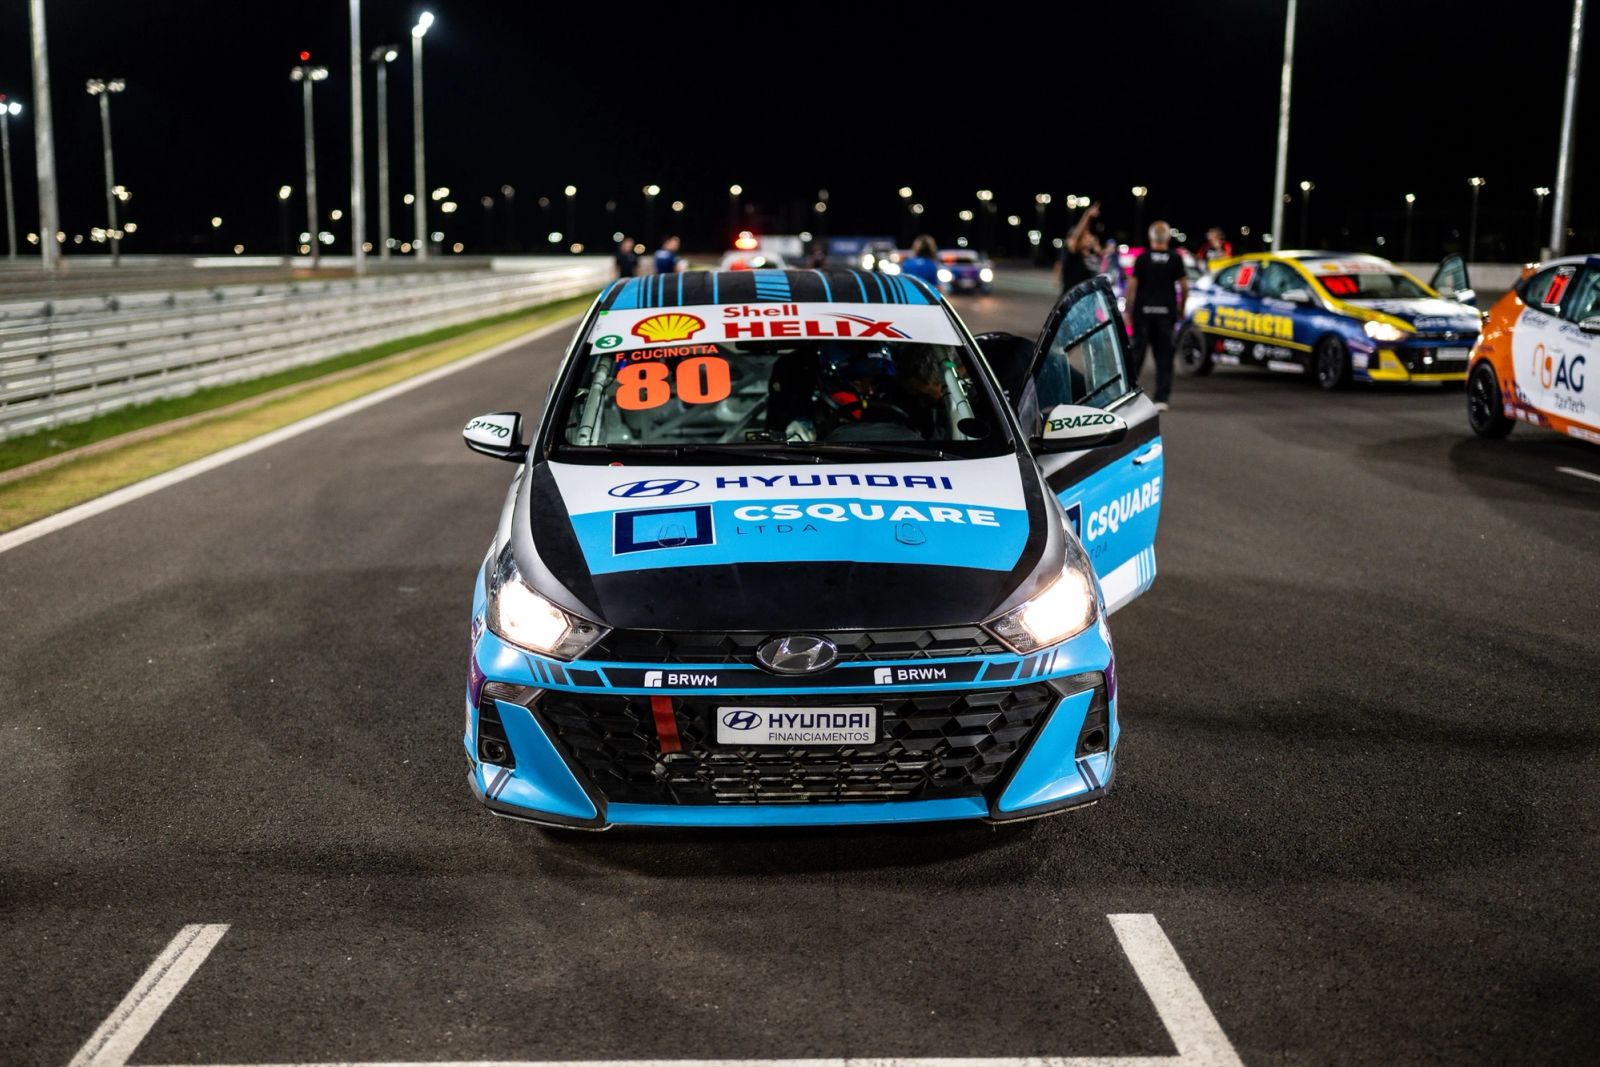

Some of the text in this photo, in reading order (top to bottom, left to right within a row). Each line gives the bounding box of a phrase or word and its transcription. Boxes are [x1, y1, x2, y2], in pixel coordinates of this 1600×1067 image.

[723, 304, 798, 318] Shell
[723, 319, 905, 339] HELIX
[631, 344, 719, 360] CUCINOTTA
[1554, 354, 1586, 393] AG
[615, 356, 732, 411] 80
[1049, 414, 1116, 431] BRAZZO
[715, 474, 953, 490] HYUNDAI
[733, 504, 1000, 527] CSQUARE
[1087, 476, 1160, 541] CSQUARE
[736, 523, 818, 535] LTDA
[668, 673, 717, 687] BRWM
[897, 668, 947, 681] BRWM
[768, 713, 870, 728] HYUNDAI
[768, 732, 870, 741] FINANCIAMENTOS
